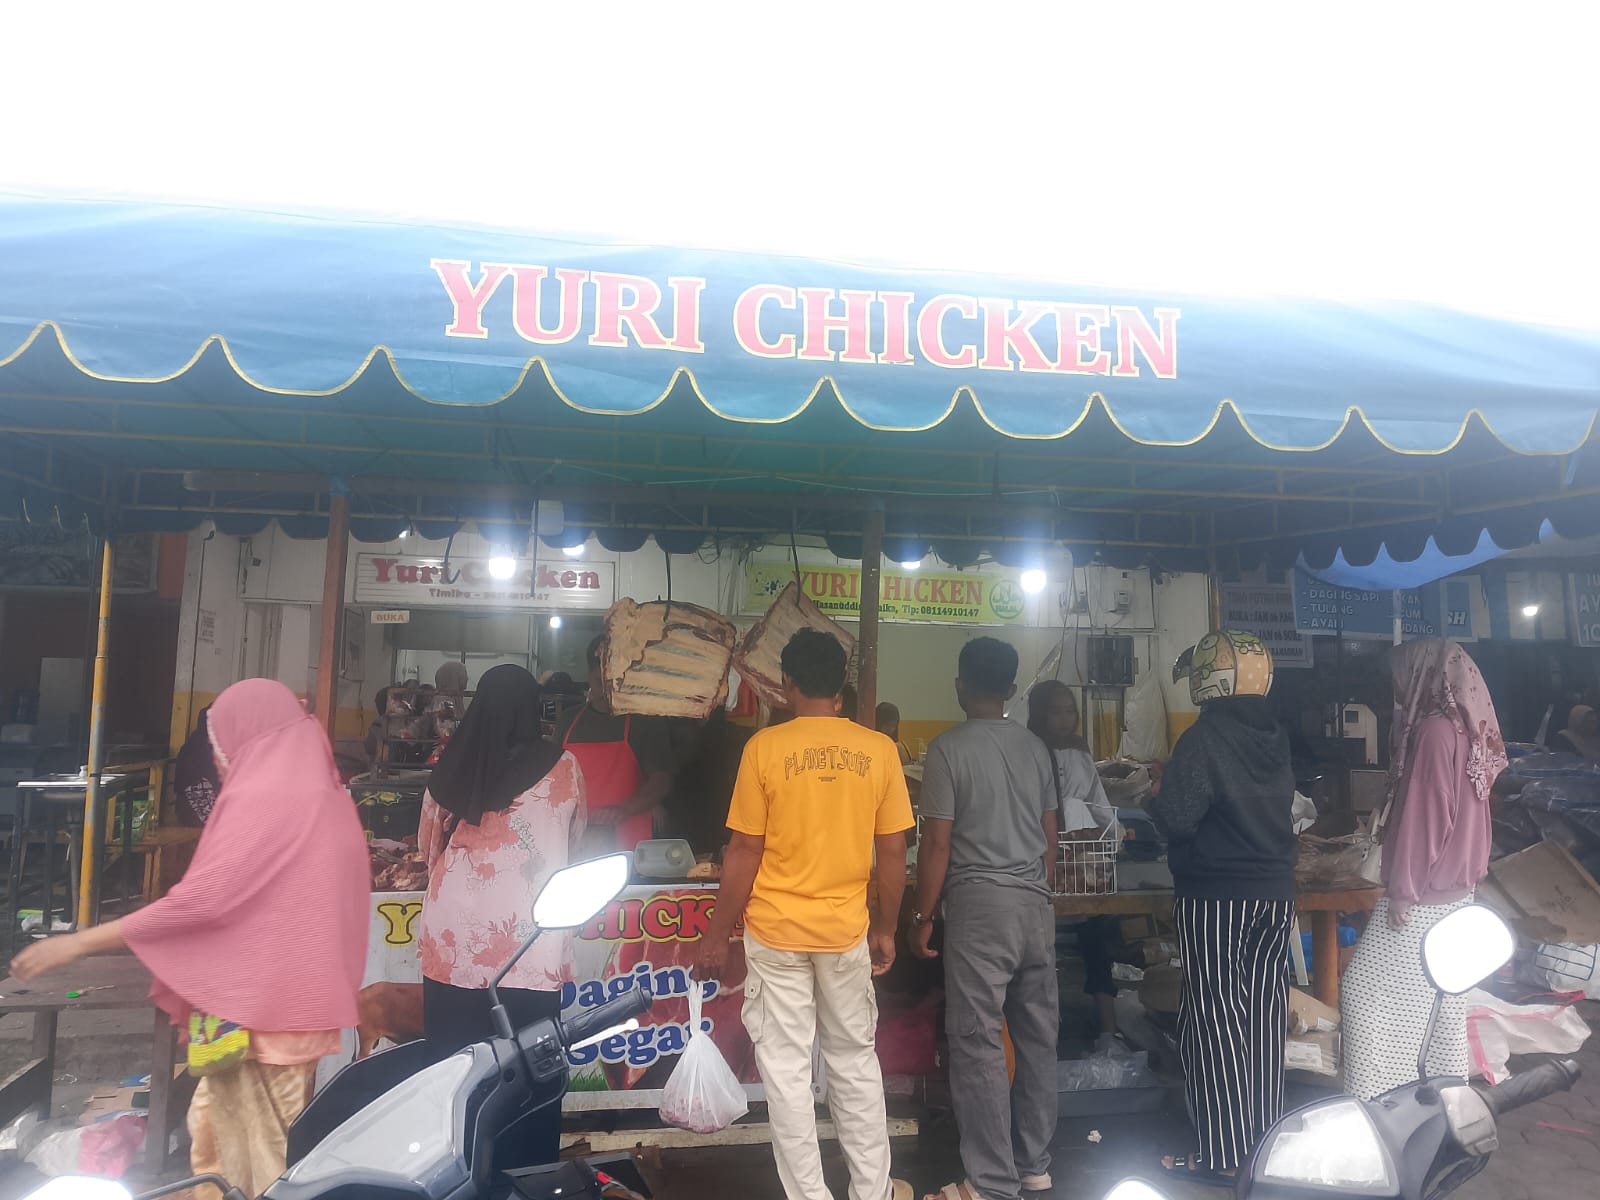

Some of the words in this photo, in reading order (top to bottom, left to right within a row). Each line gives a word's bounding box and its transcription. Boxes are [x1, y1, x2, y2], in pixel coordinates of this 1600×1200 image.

[430, 257, 706, 354] YURI
[733, 285, 1182, 380] CHICKEN
[371, 558, 450, 584] Yuri
[792, 570, 858, 599] YURI
[883, 575, 983, 606] HICKEN
[376, 613, 405, 621] BUKA
[920, 606, 980, 617] 08114910147
